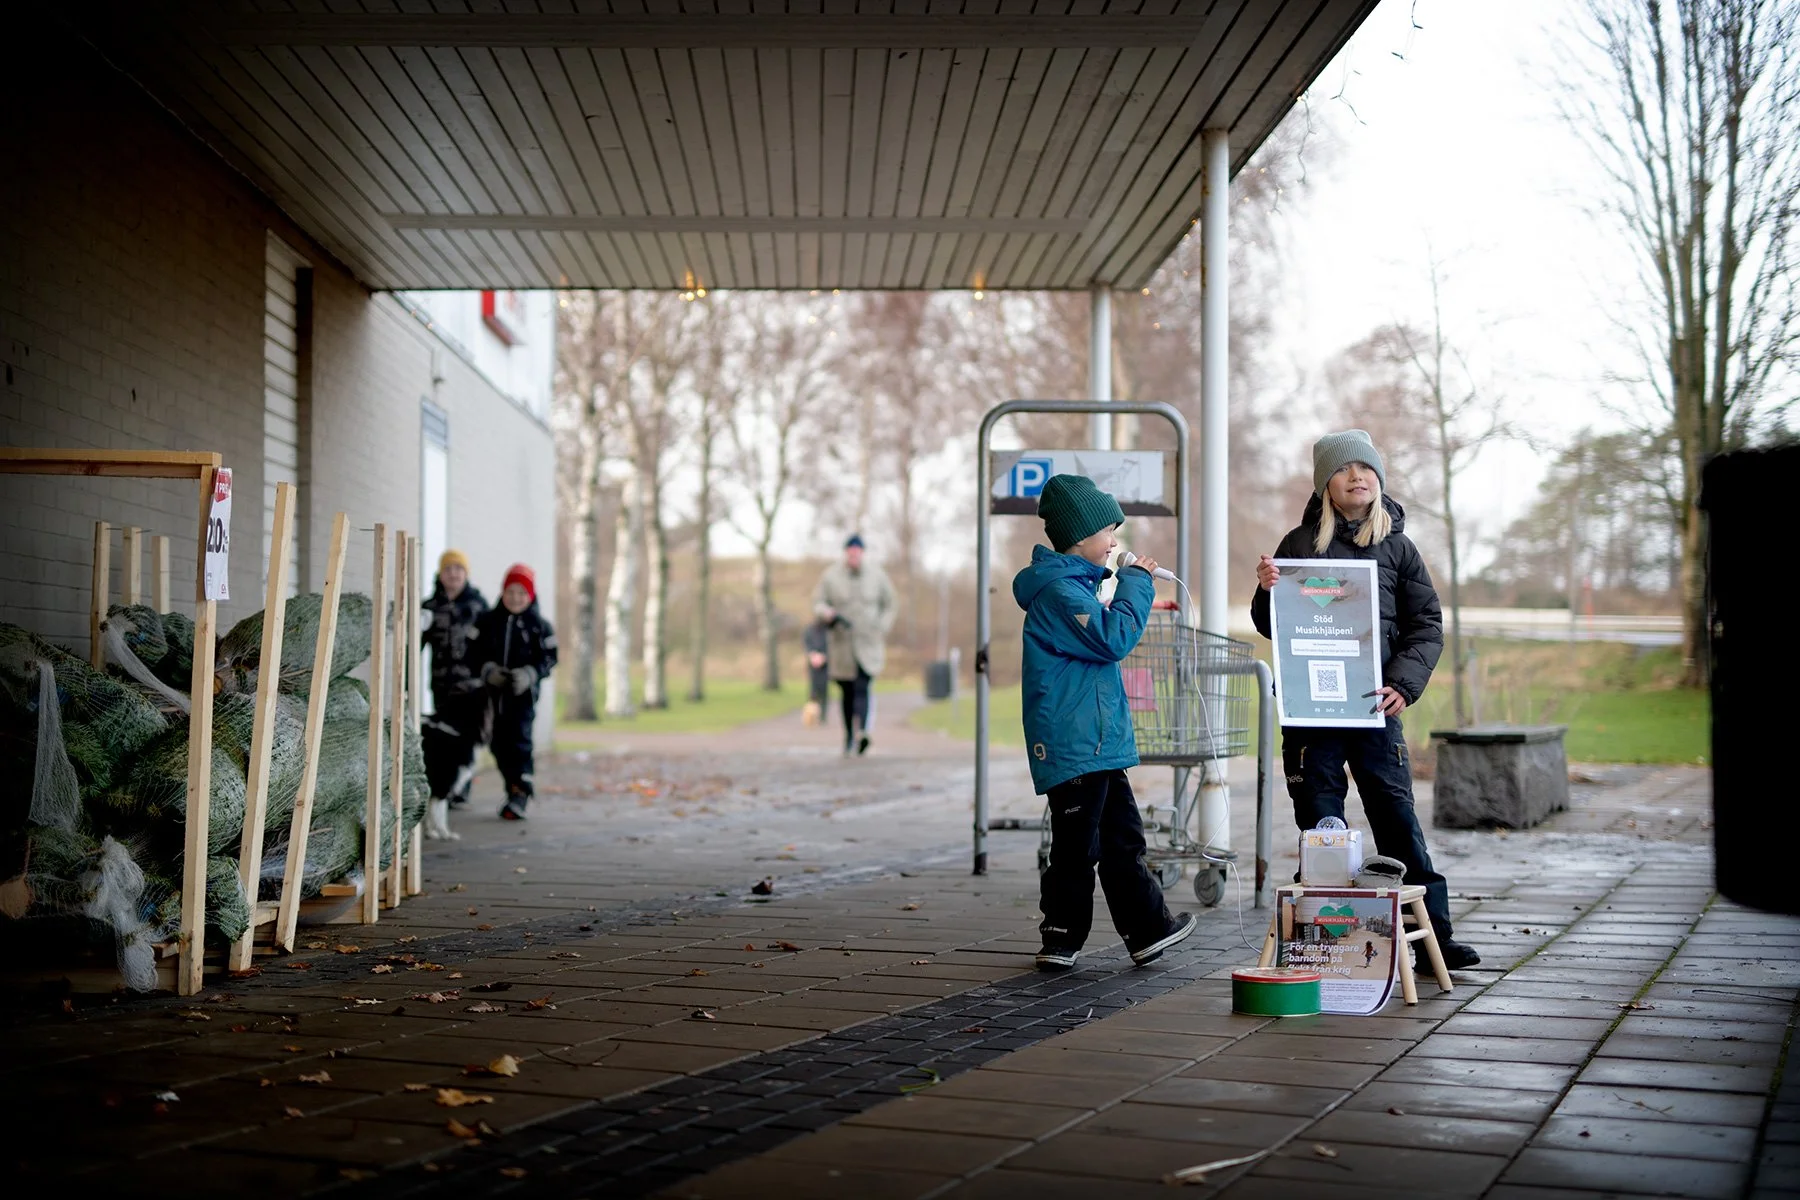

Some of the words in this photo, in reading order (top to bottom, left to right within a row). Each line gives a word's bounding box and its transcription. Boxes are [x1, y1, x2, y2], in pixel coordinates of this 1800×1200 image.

[1015, 463, 1044, 496] P
[1313, 615, 1333, 623] Stöd
[1295, 626, 1353, 637] Musikhjälpen!
[1289, 942, 1305, 950] För
[1320, 943, 1359, 953] tryggare
[1288, 954, 1329, 962] barndom
[1333, 965, 1352, 975] krig
